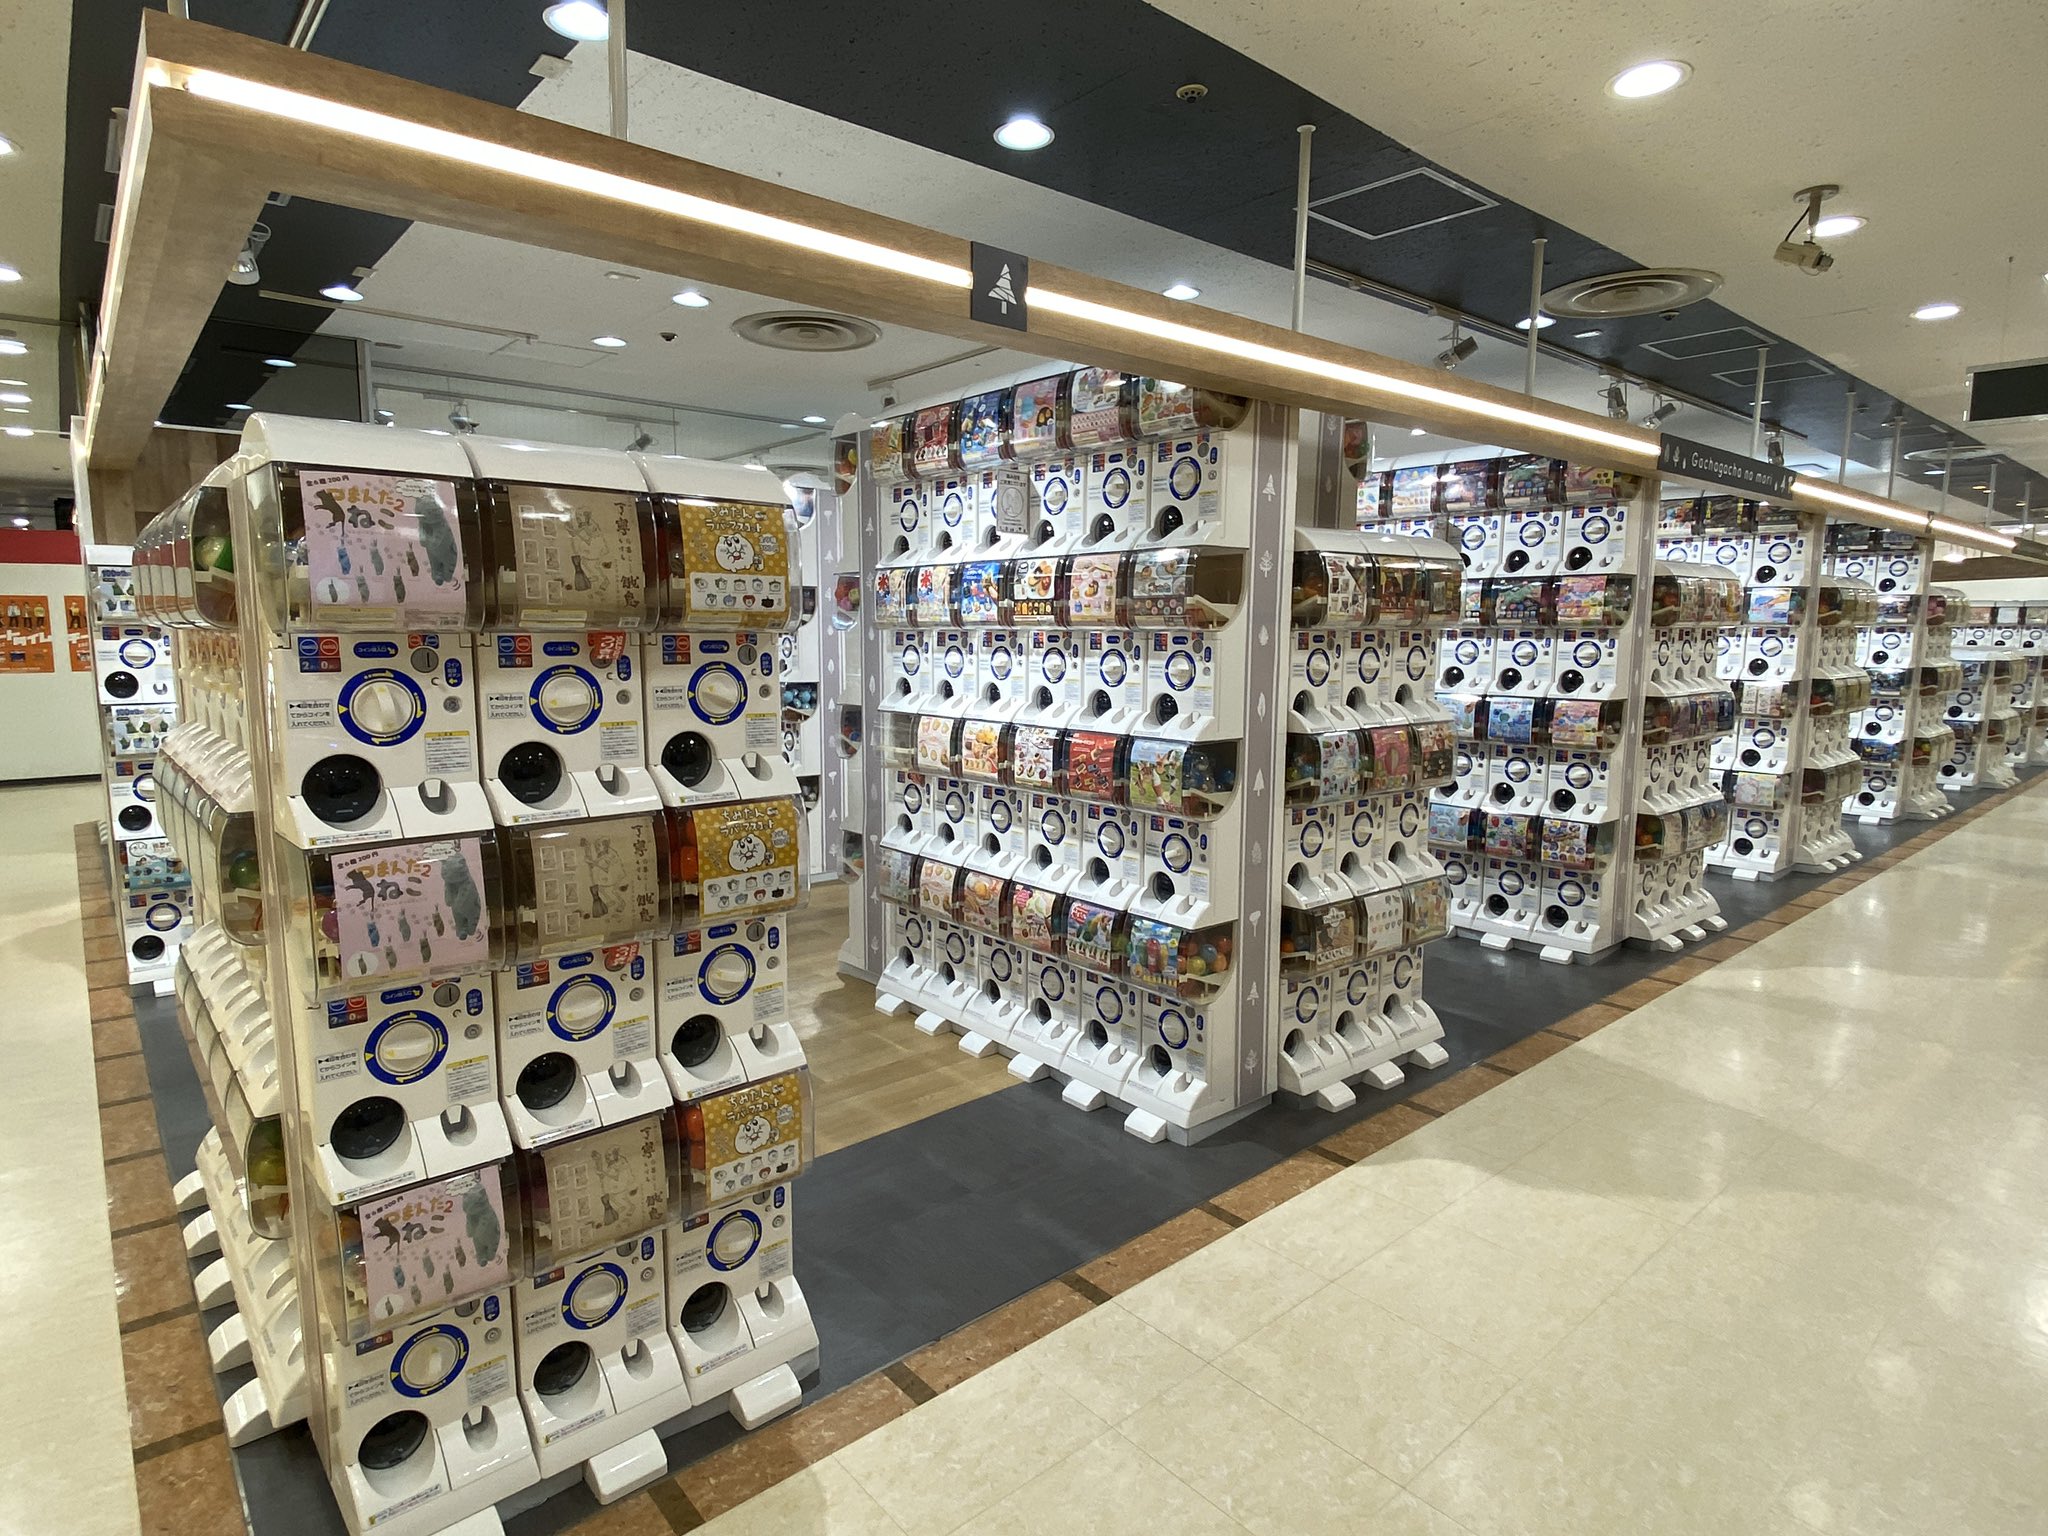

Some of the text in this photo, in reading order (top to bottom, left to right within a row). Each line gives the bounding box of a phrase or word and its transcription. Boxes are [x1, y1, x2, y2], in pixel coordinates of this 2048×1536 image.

[1691, 452, 1773, 485] Gachagacha no mori
[347, 505, 395, 530] ねこ
[376, 877, 422, 901] ねこ
